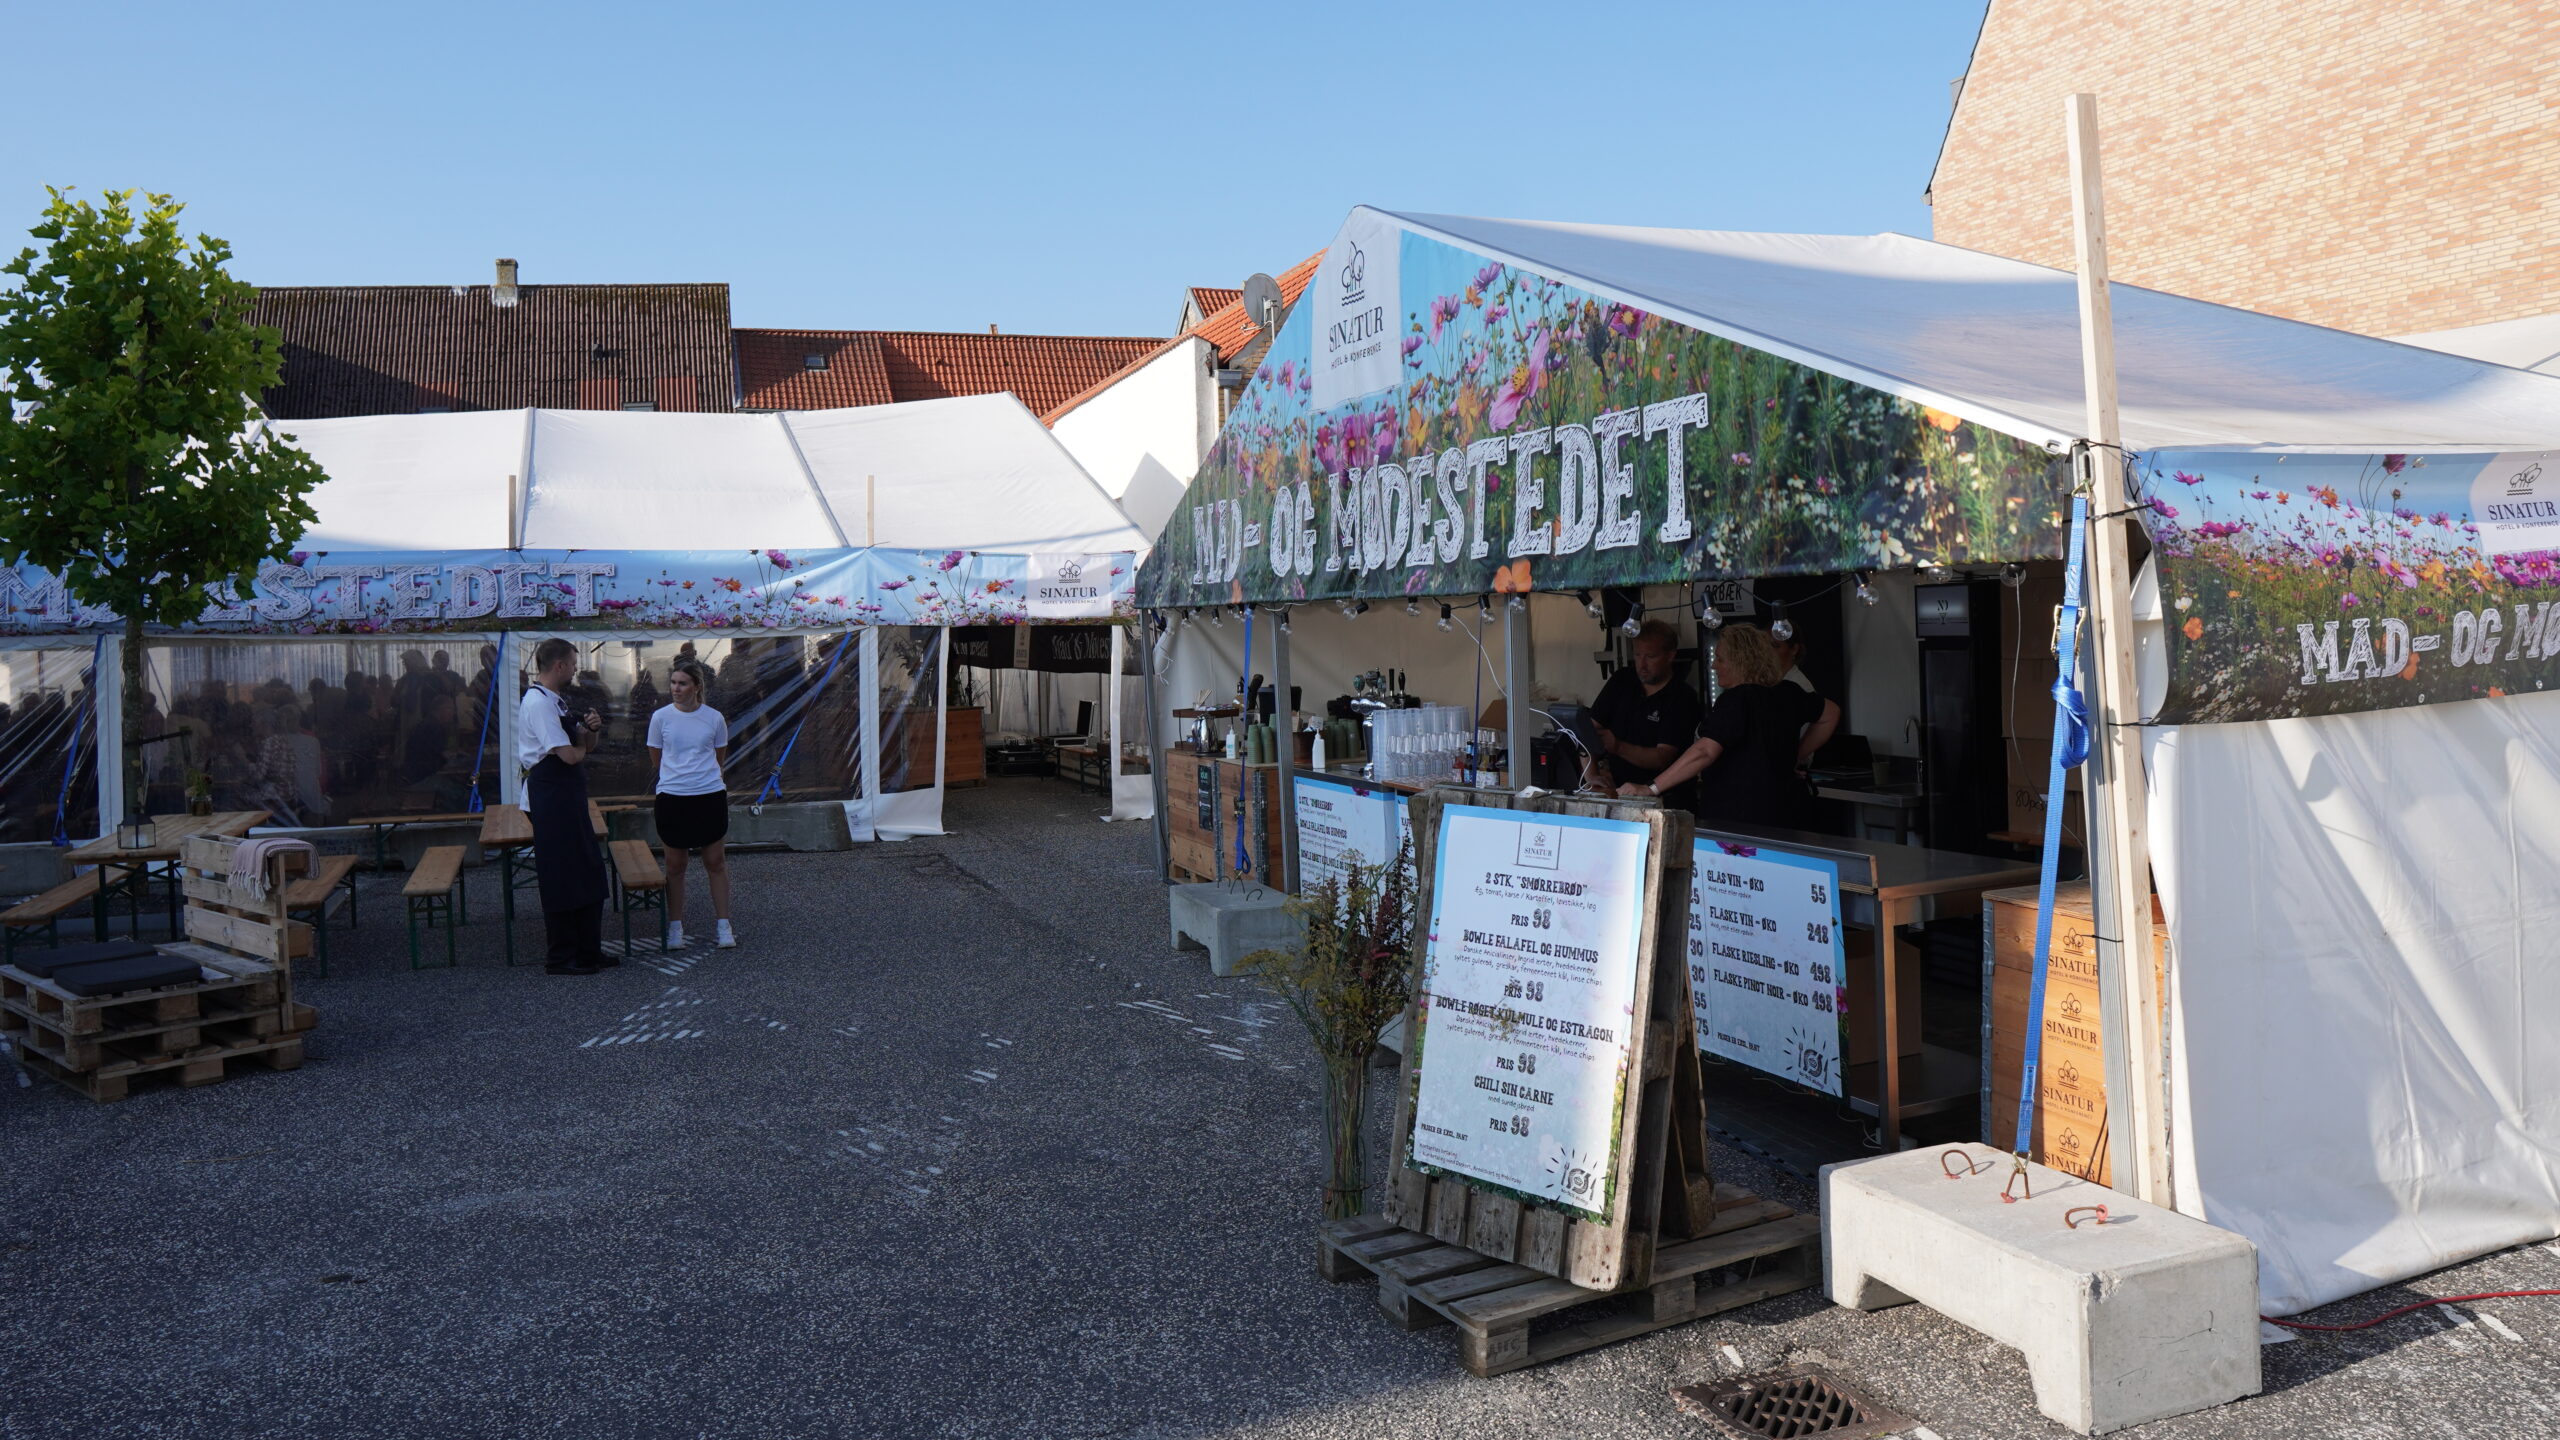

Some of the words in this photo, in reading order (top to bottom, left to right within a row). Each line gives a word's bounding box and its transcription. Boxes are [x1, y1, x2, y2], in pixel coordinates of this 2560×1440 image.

[1329, 306, 1383, 353] SINATUR
[1193, 498, 1261, 585] MAD-
[1269, 480, 1316, 578] OG
[1325, 393, 1709, 578] MØDESTEDET
[2487, 501, 2559, 520] SINATUR
[2522, 520, 2559, 529] KONFERENCE
[1040, 586, 1097, 599] SINATUR
[2297, 617, 2441, 686] MAD-
[2450, 608, 2503, 668] OG
[1524, 847, 1552, 857] SINATUR
[1485, 872, 1492, 884] 2
[1493, 873, 1514, 889] STK.
[1517, 876, 1588, 897] "SMØRREBRØD"
[1707, 869, 1726, 885] GLAS
[1727, 873, 1741, 888] VIN
[1749, 877, 1764, 892] ØKO
[1811, 883, 1827, 904] 55
[1485, 887, 1503, 898] tomat,
[1504, 890, 1520, 899] karse
[1525, 893, 1555, 906] Kartoffel,
[1587, 902, 1597, 912] løg
[1511, 914, 1529, 927] PRIS
[1532, 908, 1552, 930] 98
[1709, 906, 1738, 924] FLASKE
[1739, 912, 1754, 927] VIN
[1761, 917, 1777, 932] ØKO
[1807, 922, 1829, 944] 248
[1463, 929, 1494, 946] BOWLE
[1495, 934, 1538, 954] FALAFEL
[1540, 942, 1552, 956] OG
[1554, 944, 1599, 963] HUMMUS
[1690, 939, 1704, 957] 30
[1691, 964, 1705, 983] 30
[1712, 942, 1740, 961] FLASKE
[1741, 950, 1776, 970] RIESLING
[1784, 960, 1800, 976] ØKO
[1810, 961, 1832, 984] 498
[2048, 954, 2098, 977] SINATUR
[1504, 984, 1523, 999] PRIS
[1525, 980, 1544, 1002] 98
[1694, 990, 1707, 1010] 55
[1713, 968, 1742, 988] FLASKE
[1743, 976, 1766, 994] PINOT
[1766, 983, 1785, 1000] NOIR
[1792, 990, 1809, 1007] ØKO
[1812, 990, 1833, 1013] 498
[1436, 996, 1467, 1013] BOWLE
[1468, 1001, 1497, 1019] RØGET
[1497, 1007, 1545, 1029] KULMULE
[1545, 1018, 1558, 1032] OG
[1559, 1020, 1614, 1043] ESTRAGON
[1696, 1017, 1709, 1036] 75
[2046, 1019, 2097, 1045] SINATUR
[1512, 1037, 1549, 1052] fermenteret
[1496, 1056, 1514, 1071] PRIS
[1518, 1052, 1536, 1075] 98
[1474, 1075, 1499, 1093] CHILI
[1501, 1081, 1518, 1097] SIN
[1519, 1086, 1554, 1106] CARNE
[2043, 1087, 2094, 1113] SINATUR
[1489, 1117, 1507, 1132] PRIS
[1511, 1114, 1530, 1137] 98
[2044, 1152, 2095, 1181] SINATUR
